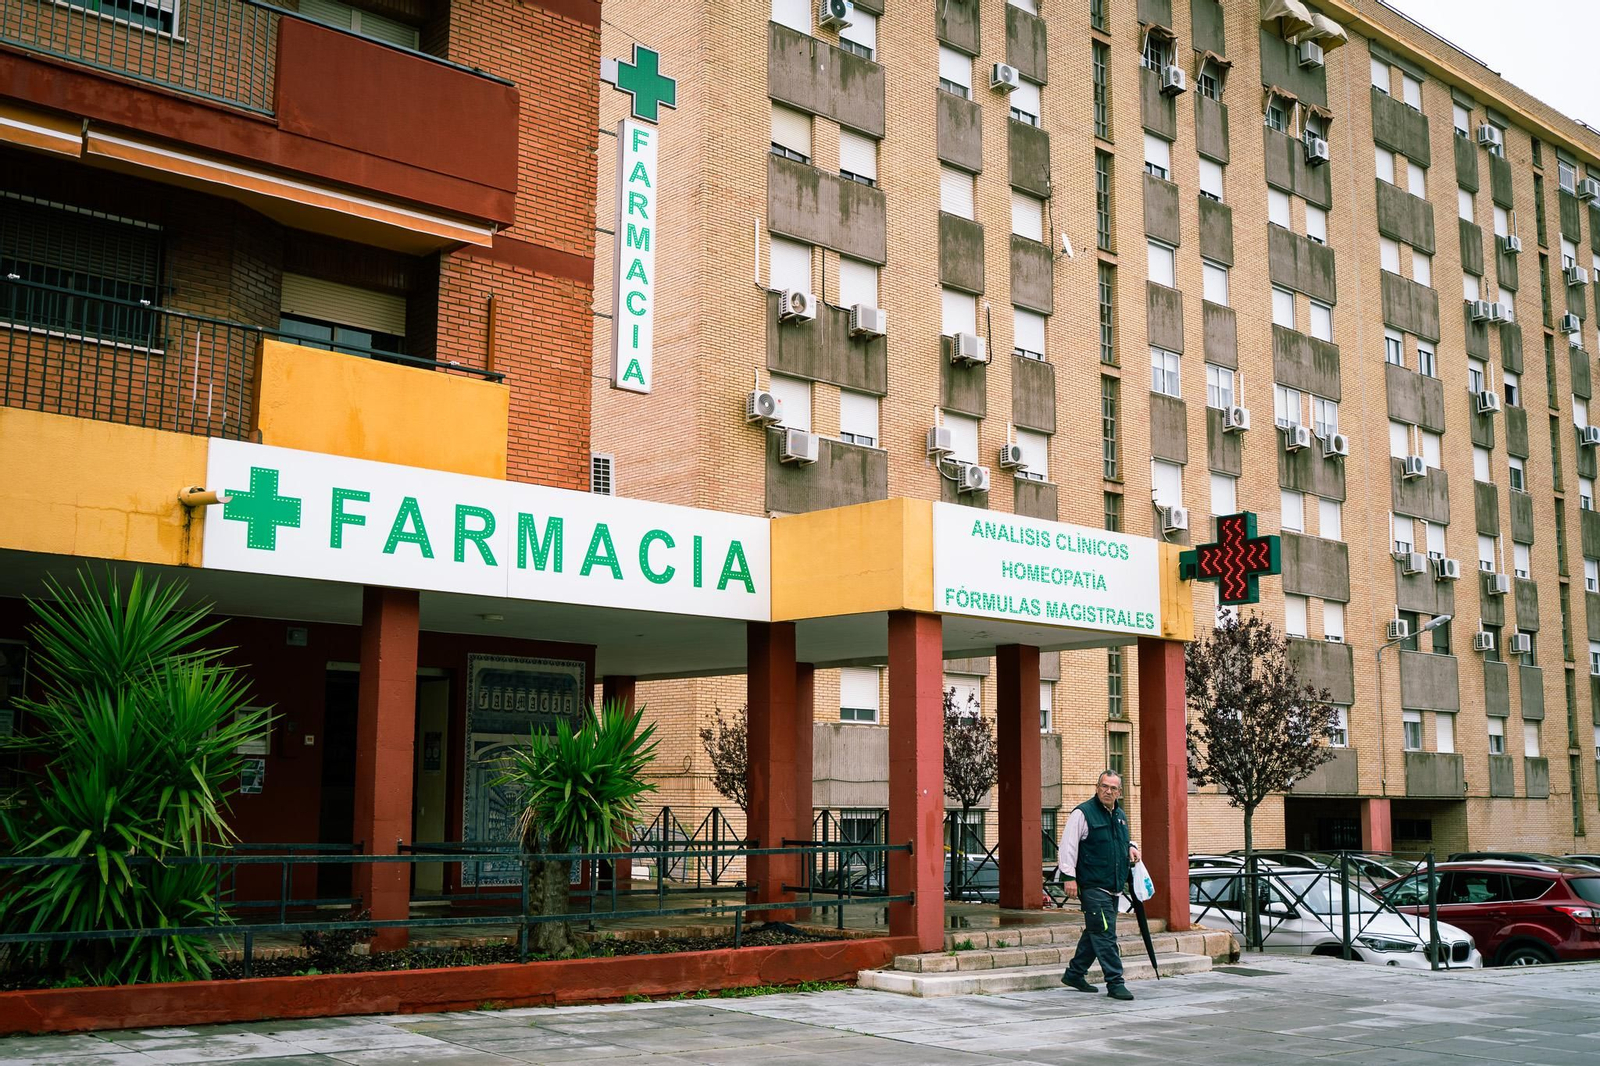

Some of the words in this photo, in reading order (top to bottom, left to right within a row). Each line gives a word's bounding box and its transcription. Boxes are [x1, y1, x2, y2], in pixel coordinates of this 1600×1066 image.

[623, 128, 651, 385] FARMACIA
[329, 486, 756, 594] FARMACIA
[971, 519, 1051, 549] ANALISIS
[1046, 600, 1155, 629] MAGISTRALES
